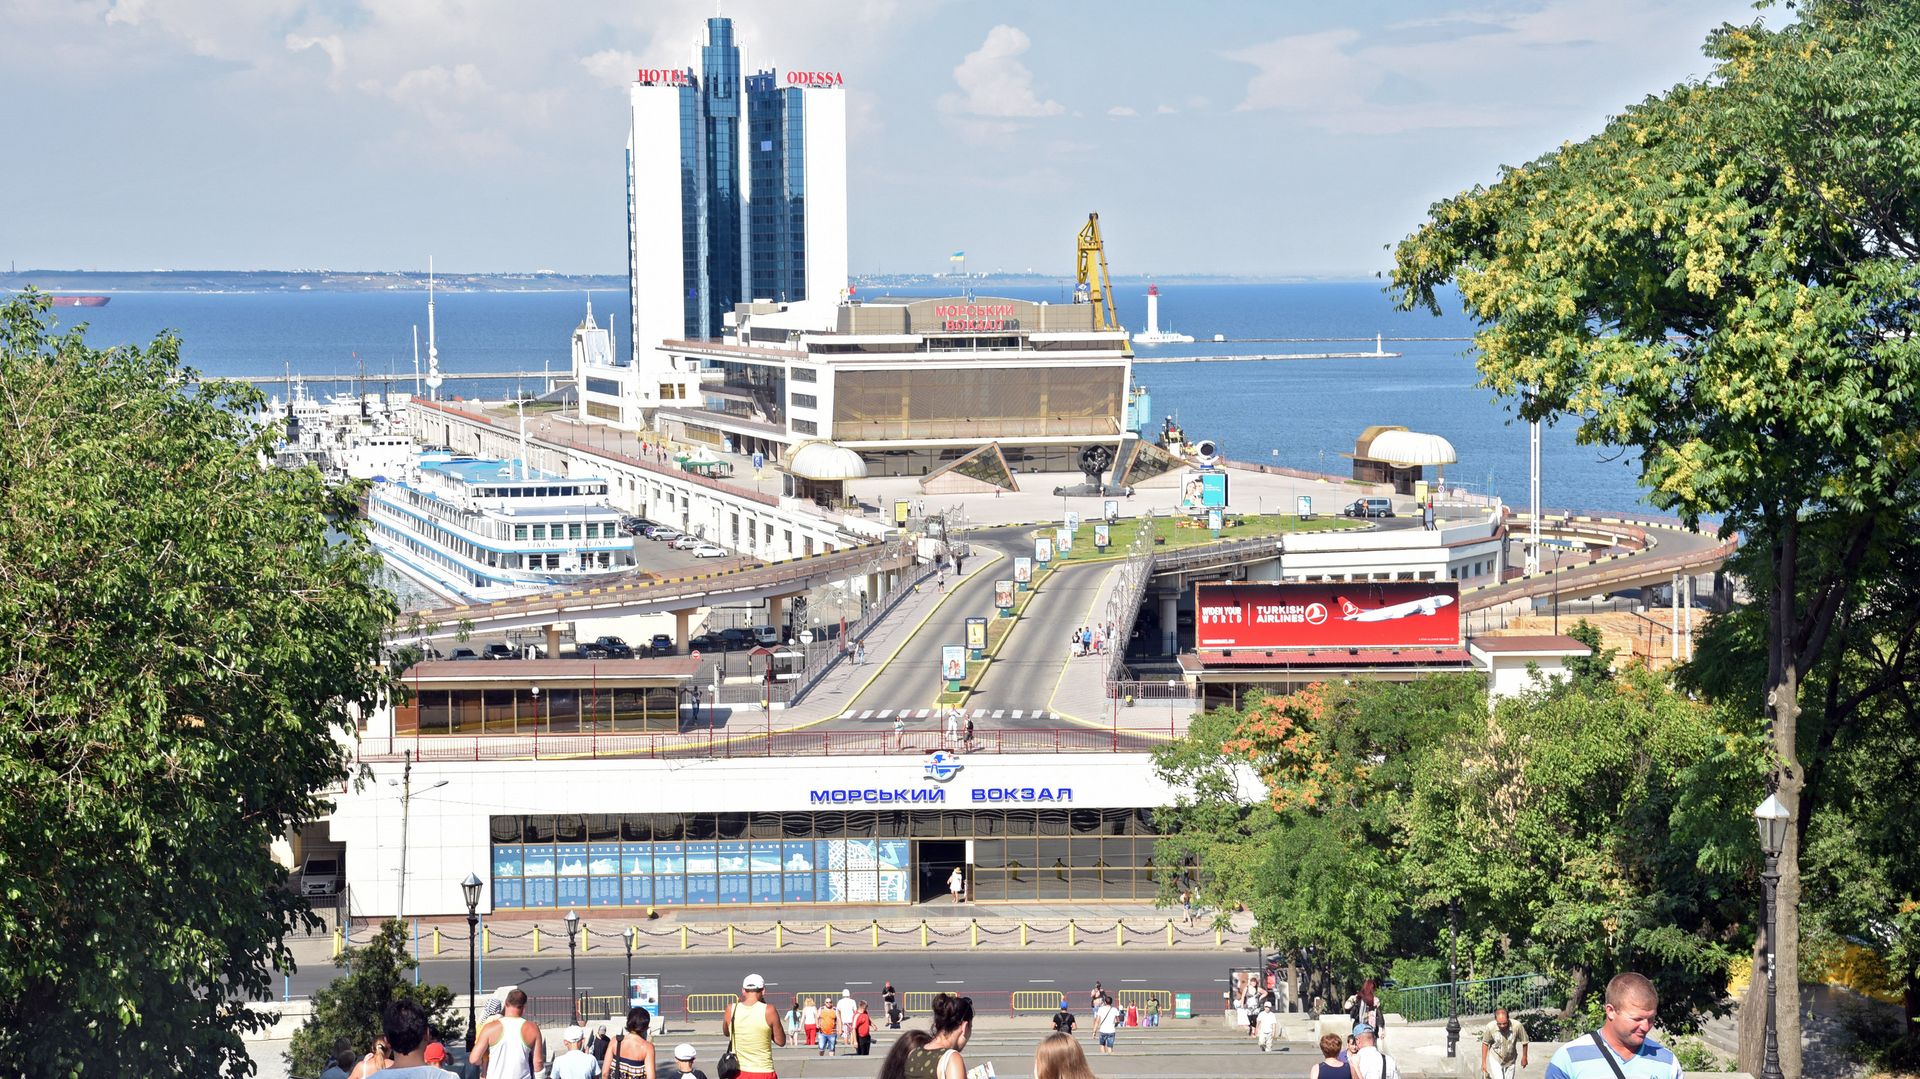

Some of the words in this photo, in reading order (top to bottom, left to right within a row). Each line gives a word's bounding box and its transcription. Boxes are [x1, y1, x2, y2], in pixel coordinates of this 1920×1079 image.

[638, 69, 689, 83] HOTEL
[787, 71, 844, 84] ODESSA
[935, 304, 1015, 317] МОРСЬКИЙ
[946, 319, 1005, 331] ВОКЗАЛ
[1202, 607, 1223, 615] WIDEN
[1224, 606, 1242, 615] YOUR
[1256, 605, 1304, 615] TURKISH
[1256, 614, 1304, 623] AIRLINES
[810, 786, 945, 802] МОРСЬКИЙ
[971, 788, 1073, 801] ВОКЗАЛ
